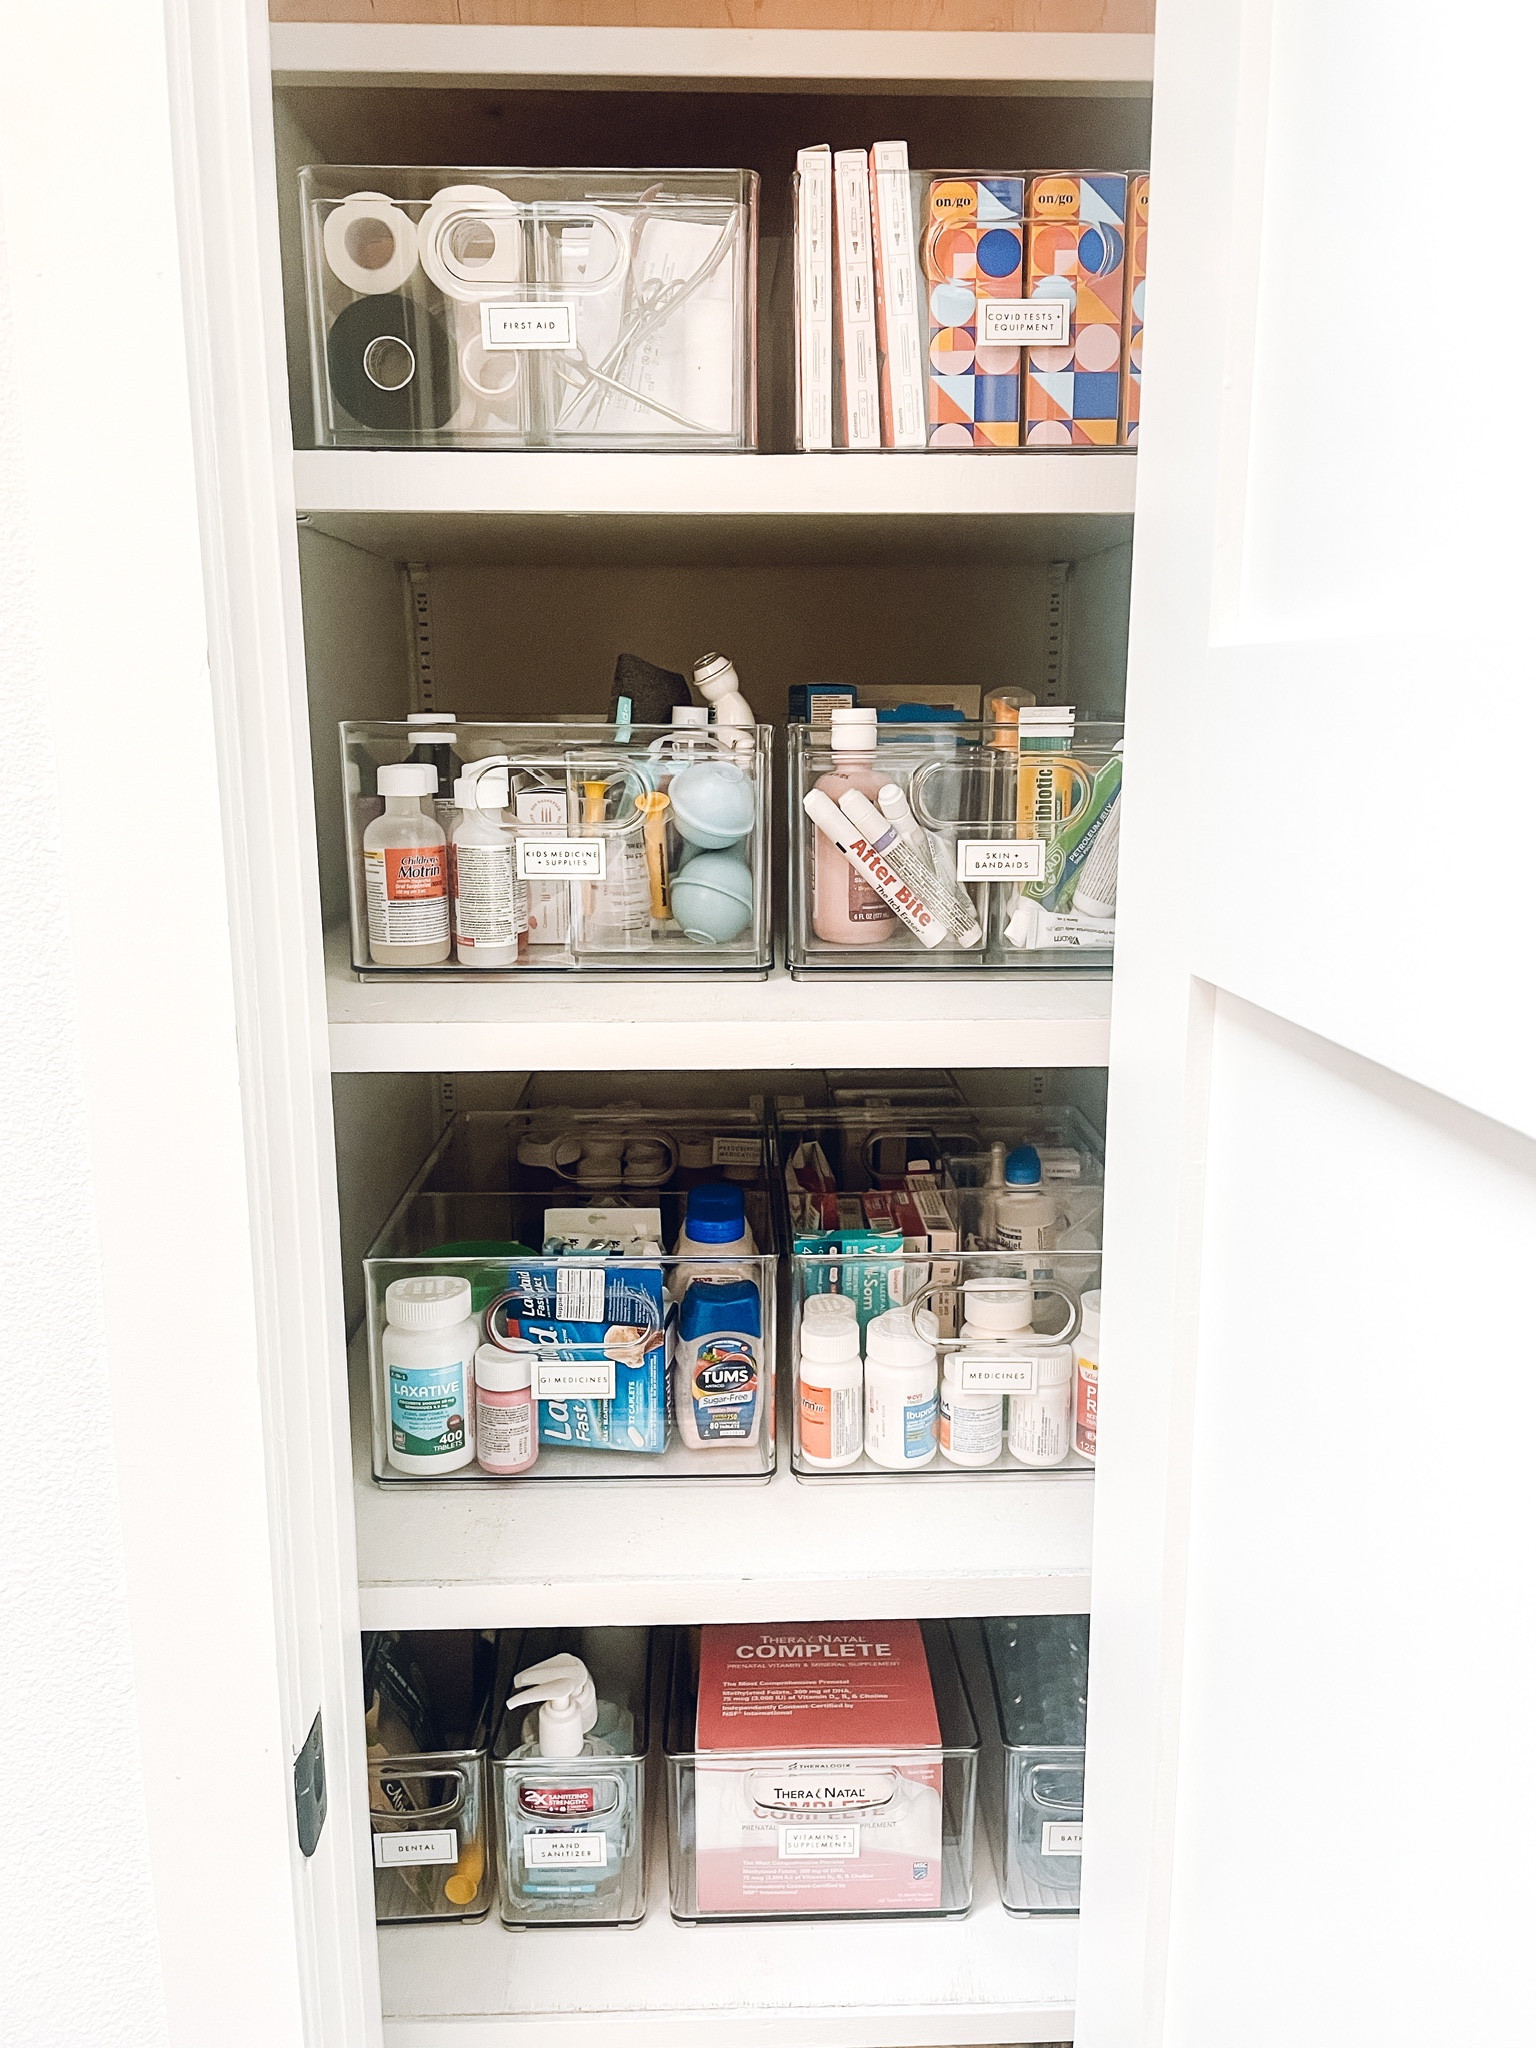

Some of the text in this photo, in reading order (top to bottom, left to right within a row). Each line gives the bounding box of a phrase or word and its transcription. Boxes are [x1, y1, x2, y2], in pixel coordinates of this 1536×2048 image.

[935, 197, 971, 208] on/go
[1038, 194, 1073, 205] on/go
[987, 313, 1021, 321] COVID
[1024, 313, 1053, 321] TESTS
[503, 321, 555, 330] FIRST AID
[994, 323, 1054, 332] EQUIPMENT
[1068, 820, 1101, 863] PETROLEUM
[1099, 803, 1112, 825] JELLY
[975, 861, 1029, 869] BANDAIDS
[398, 865, 440, 878] Motrin
[849, 839, 932, 927] After Bite
[875, 884, 921, 934] The Itch Eraser
[702, 1369, 749, 1384] TUMS
[394, 1380, 460, 1398] LAXATIVE
[702, 1393, 749, 1405] Sugar-Free
[572, 1405, 591, 1441] Fast
[709, 1422, 719, 1430] 80
[440, 1429, 463, 1444] 400
[433, 1440, 463, 1452] TABLETS
[736, 1643, 892, 1659] COMPLETE
[525, 1790, 548, 1805] 2X
[398, 1844, 435, 1852] DENTAL
[541, 1850, 591, 1858] SANITIZER
